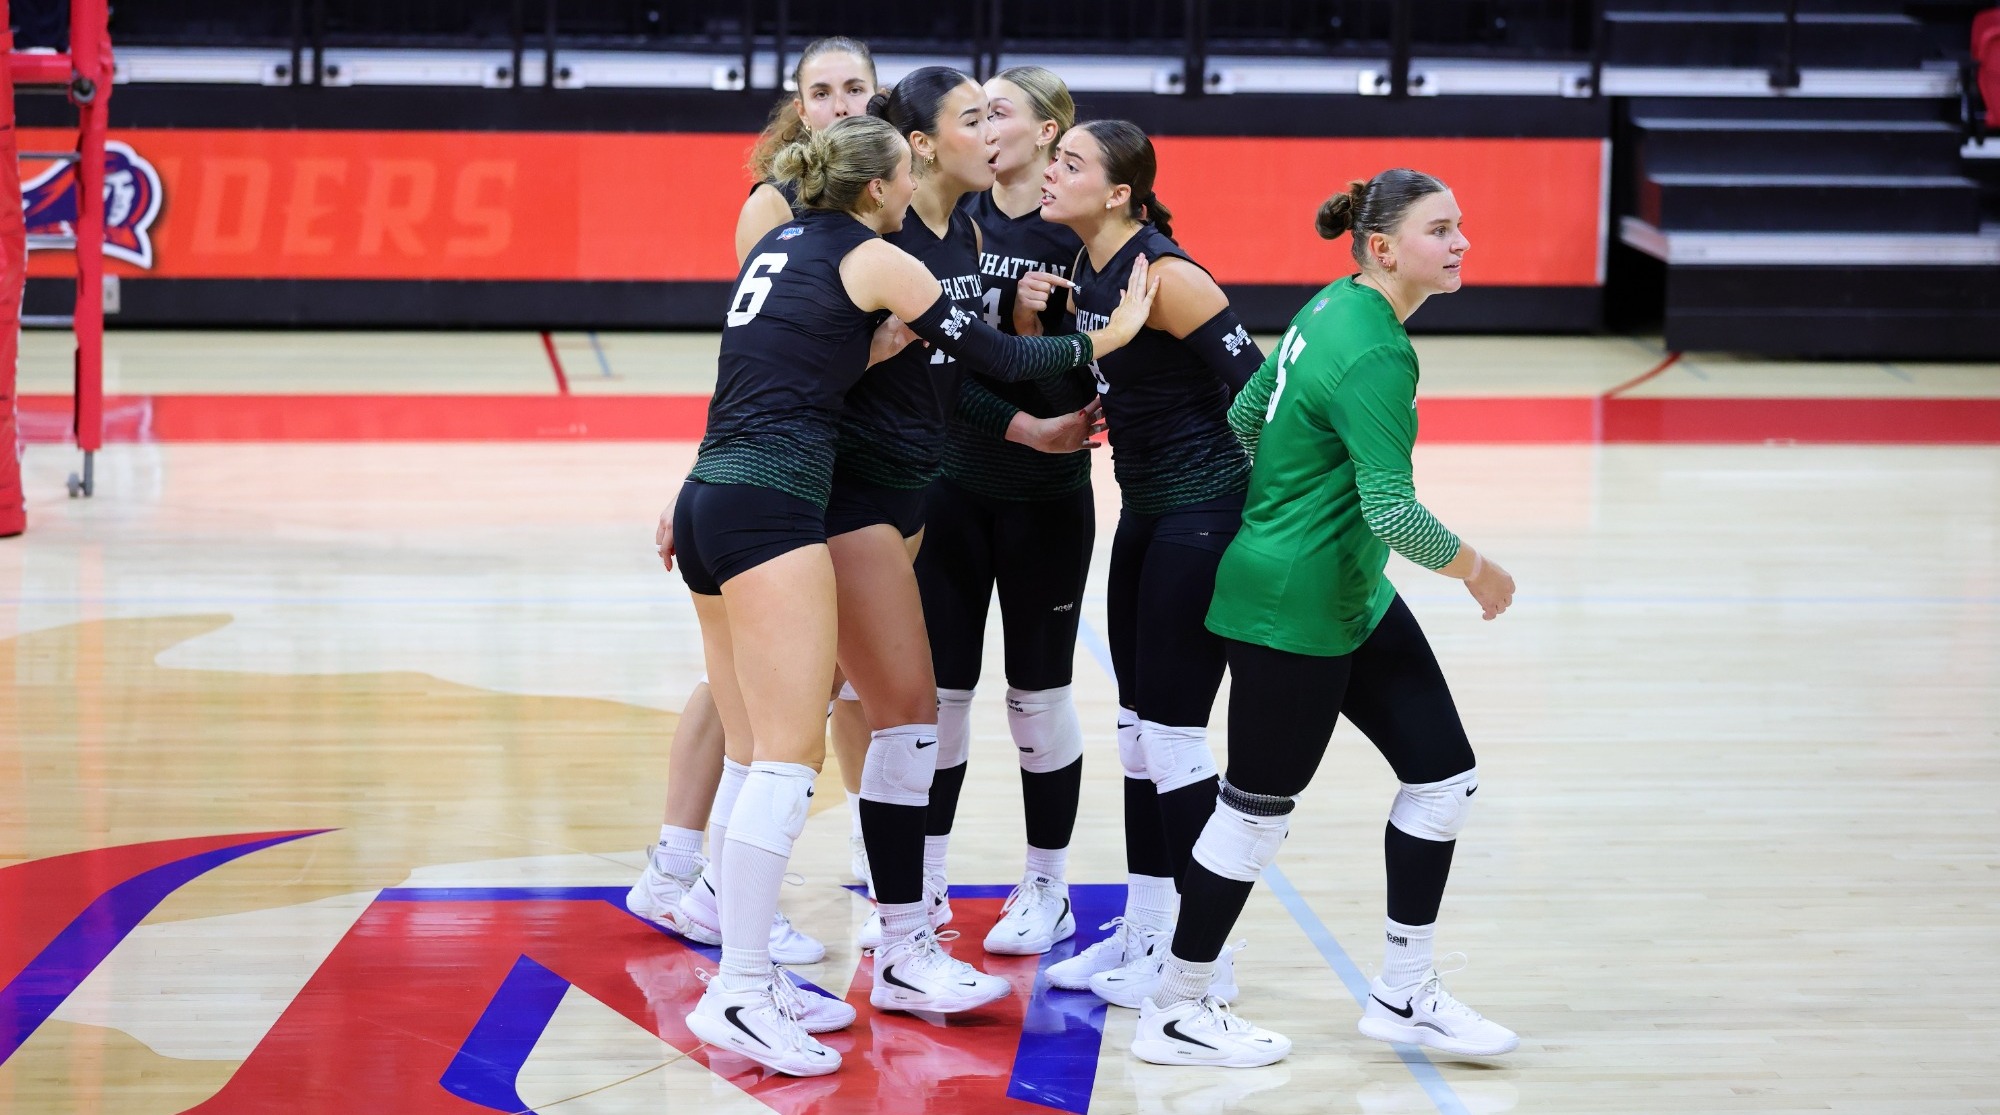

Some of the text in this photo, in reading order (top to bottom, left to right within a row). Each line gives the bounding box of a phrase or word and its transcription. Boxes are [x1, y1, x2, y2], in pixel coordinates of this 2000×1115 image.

[727, 252, 789, 328] 6
[1036, 876, 1050, 885] NIKE
[914, 929, 927, 942] NIKE
[1386, 930, 1408, 944] pelli
